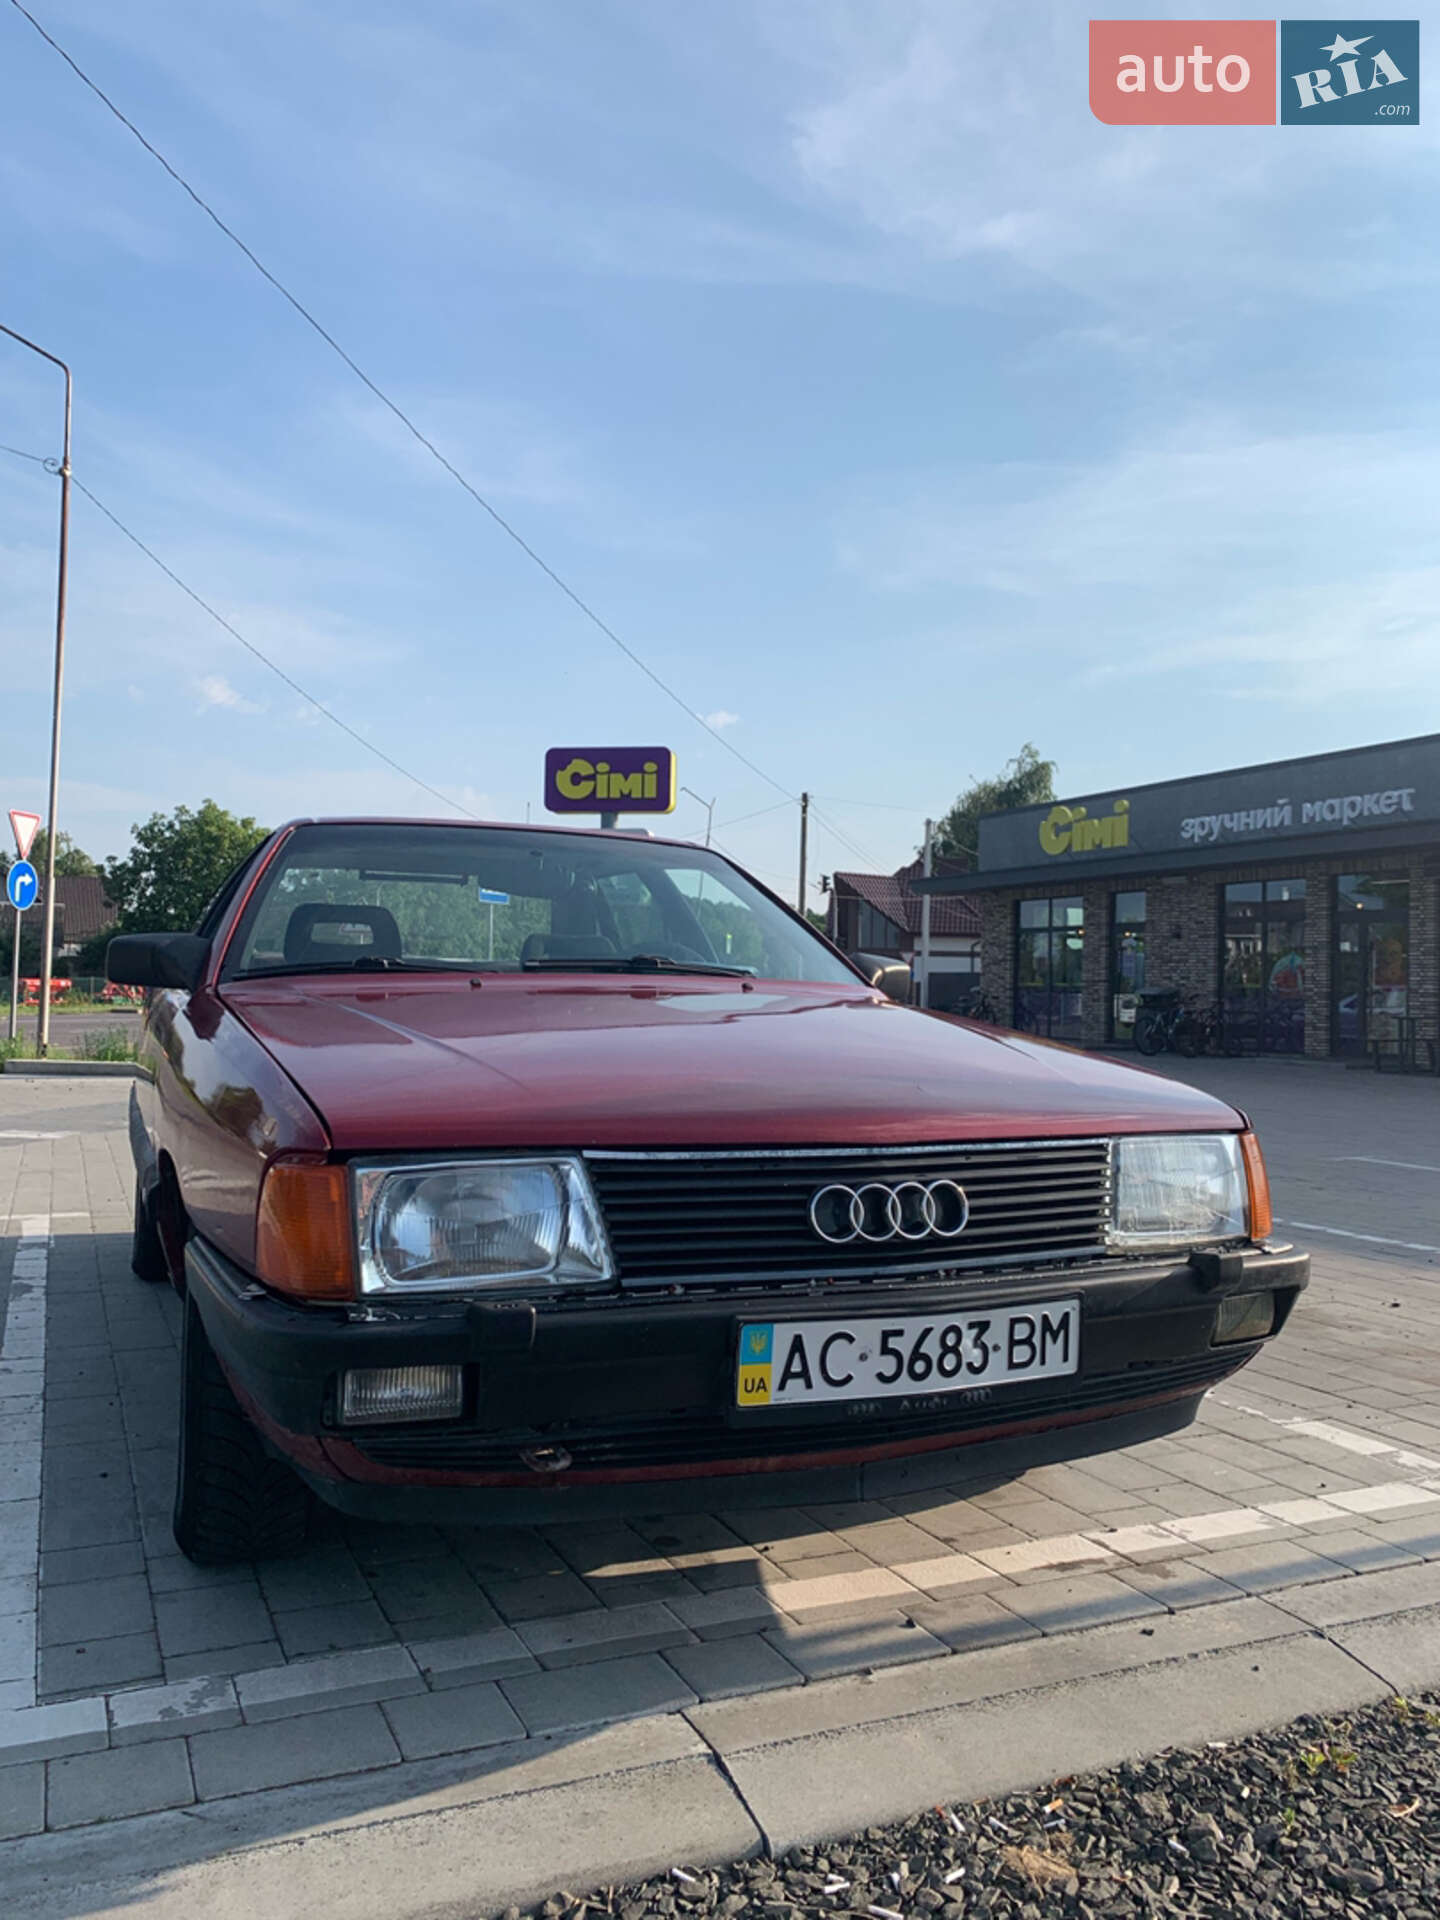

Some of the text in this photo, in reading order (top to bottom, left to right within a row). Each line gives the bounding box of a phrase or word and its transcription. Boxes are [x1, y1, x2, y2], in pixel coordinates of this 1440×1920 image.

[1180, 787, 1416, 843] зручний маркет
[777, 1311, 1071, 1391] AC 5683 BM
[743, 1377, 768, 1394] UA
